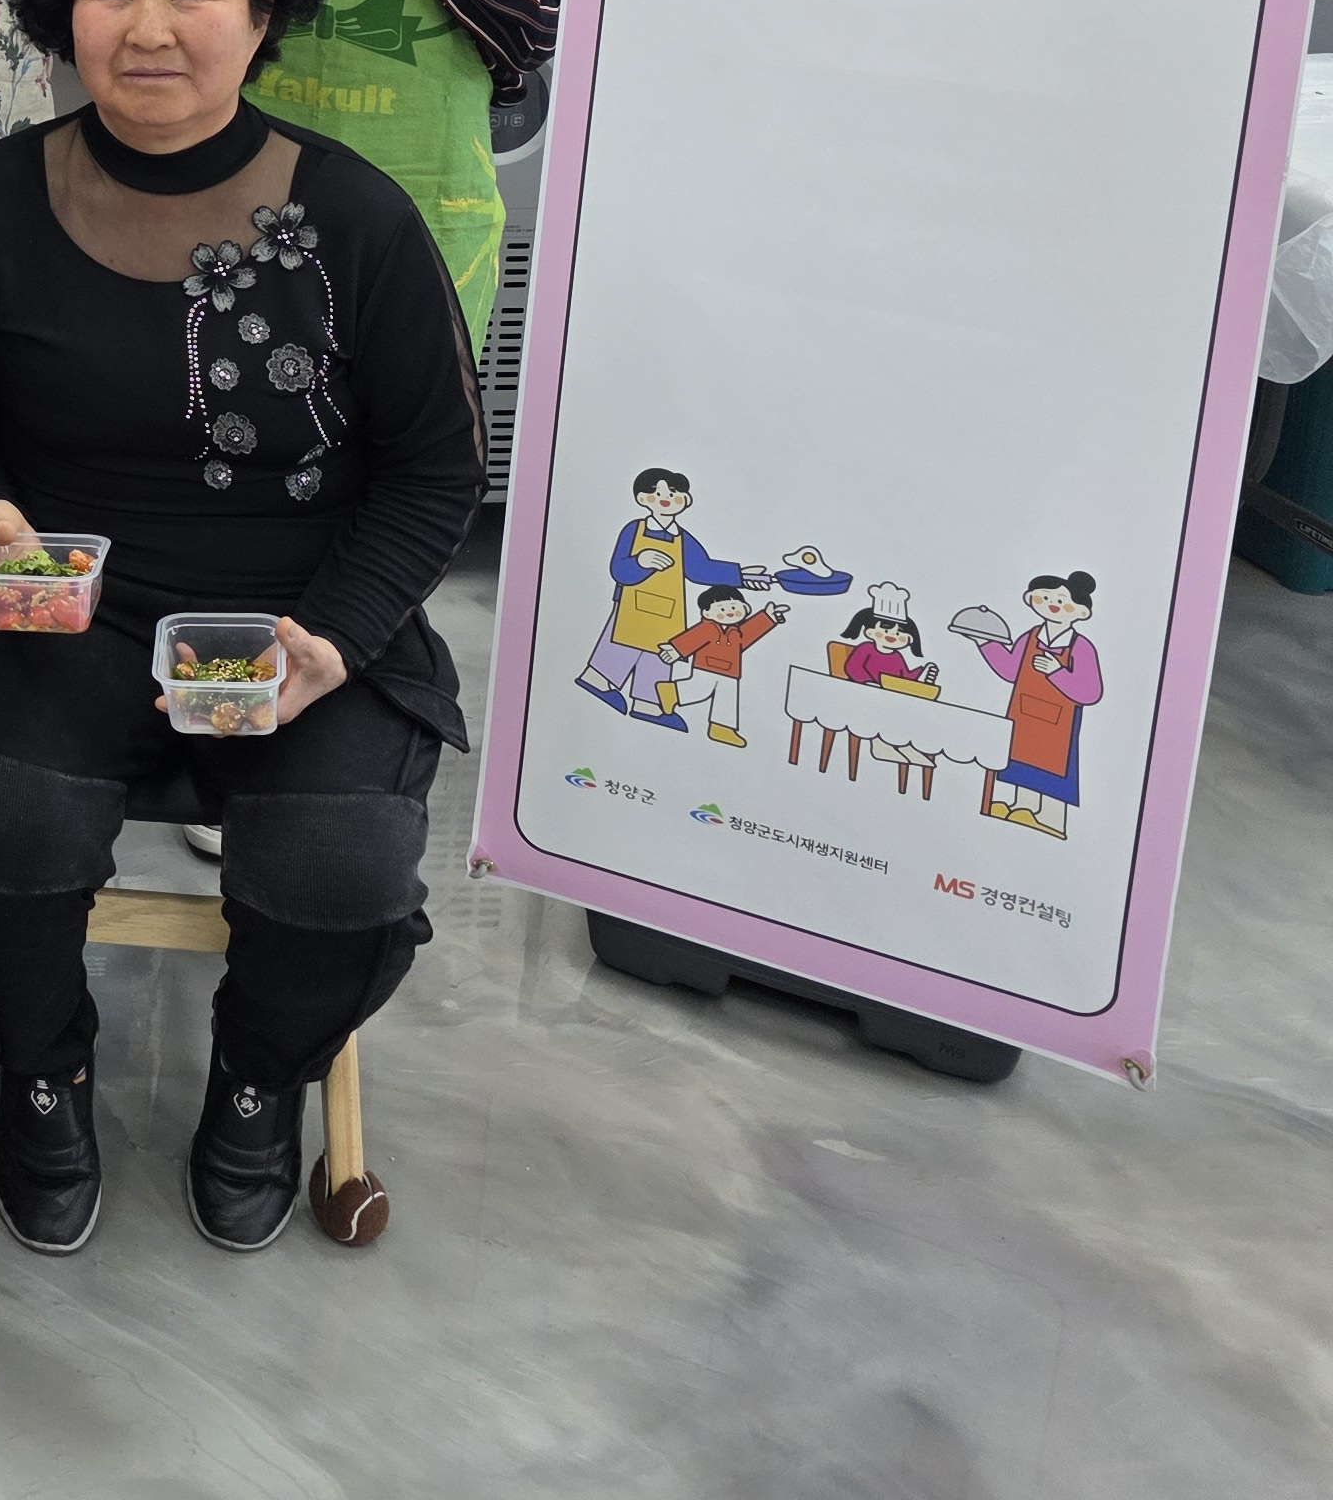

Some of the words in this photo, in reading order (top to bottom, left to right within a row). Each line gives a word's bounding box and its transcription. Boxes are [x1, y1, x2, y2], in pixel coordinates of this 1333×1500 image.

[604, 779, 657, 806] 청양군
[728, 815, 889, 875] 청양군도시재생지원센터
[933, 873, 976, 900] MS
[980, 886, 1072, 929] 경영컨설팅
